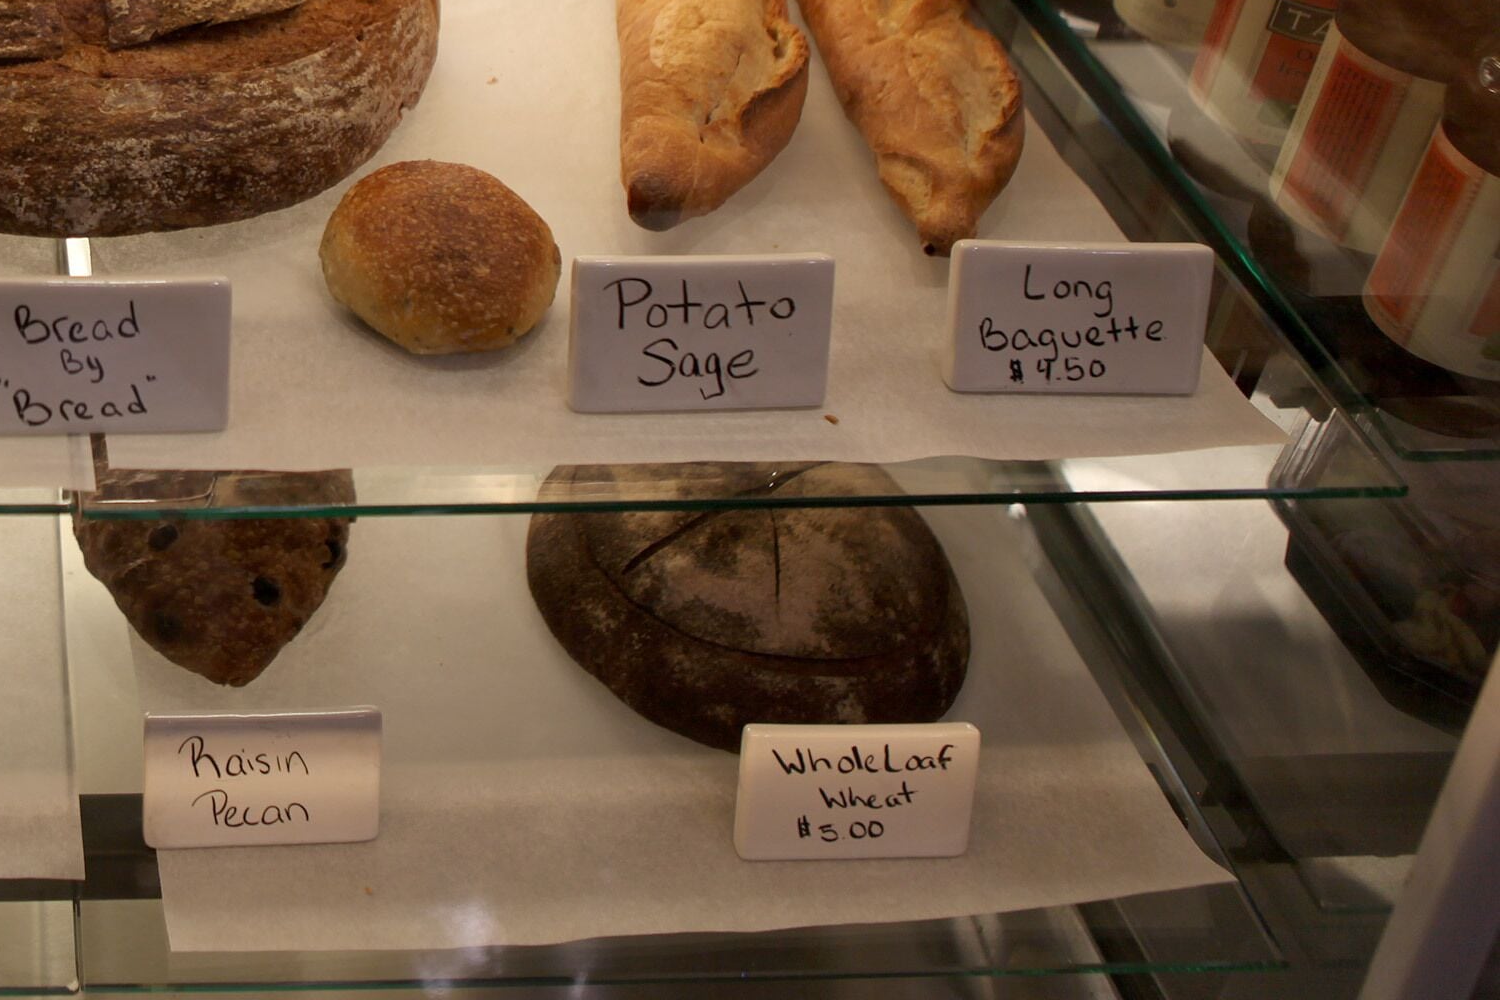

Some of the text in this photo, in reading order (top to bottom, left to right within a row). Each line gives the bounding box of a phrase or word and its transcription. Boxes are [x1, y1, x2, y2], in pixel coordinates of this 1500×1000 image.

[602, 277, 796, 330] Potato
[1023, 264, 1113, 318] Long
[13, 300, 141, 345] Bread
[978, 316, 1165, 361] Baguette
[59, 348, 105, 383] By
[637, 338, 759, 400] Sage
[177, 735, 310, 779] Raisin
[191, 788, 310, 828] Pecan
